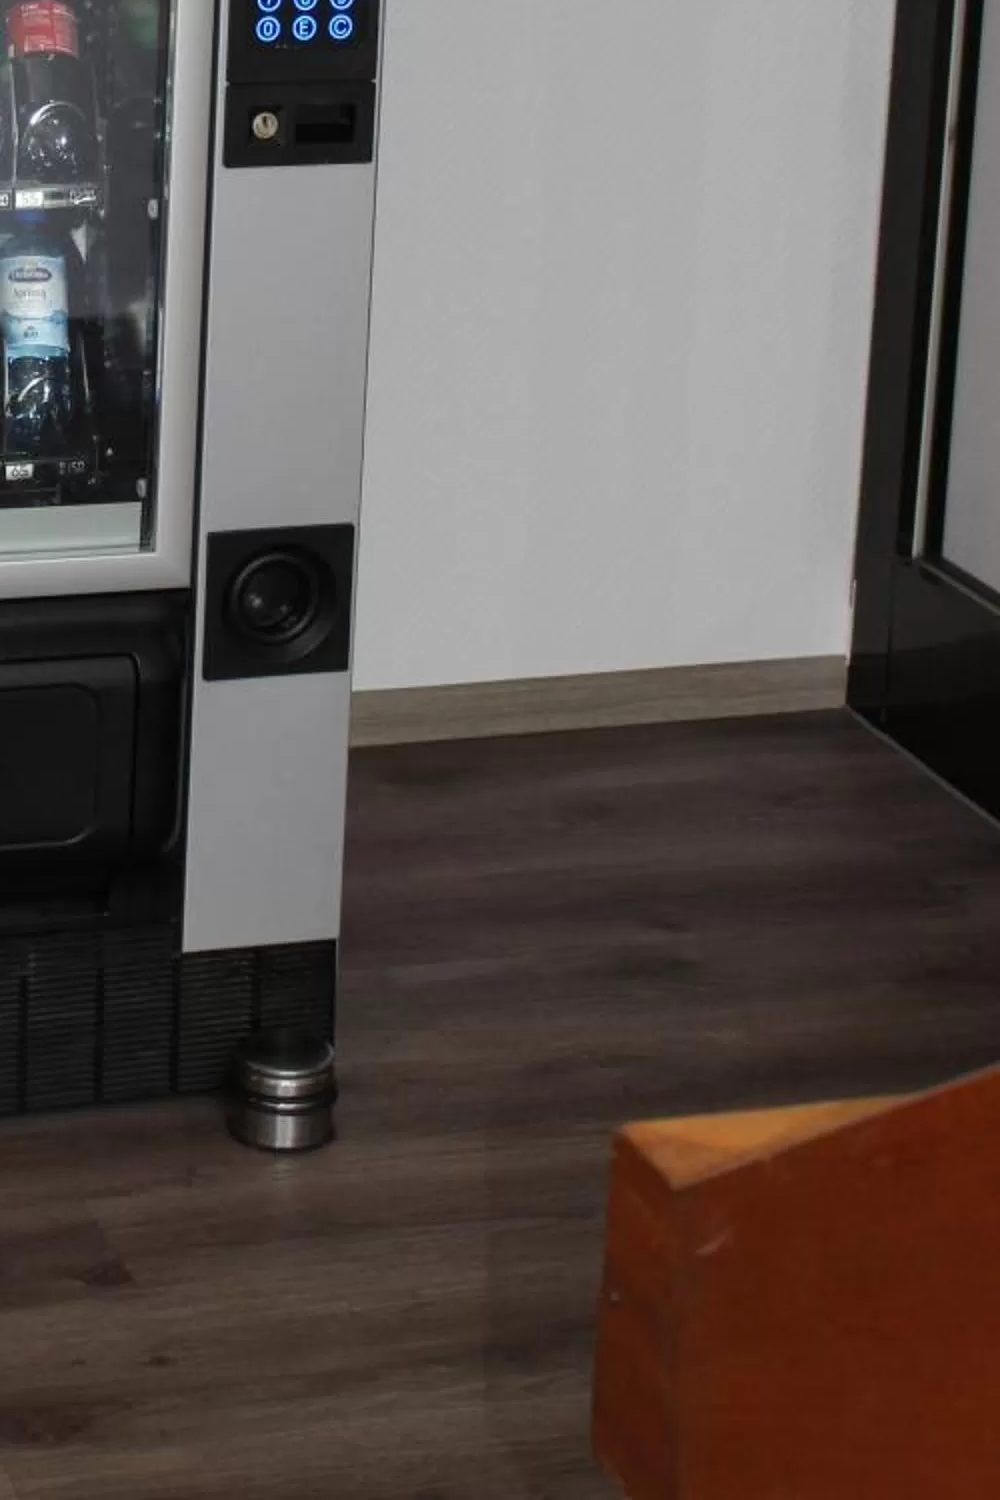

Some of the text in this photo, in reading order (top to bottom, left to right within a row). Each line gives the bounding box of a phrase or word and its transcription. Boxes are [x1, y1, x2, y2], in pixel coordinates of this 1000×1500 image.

[263, 19, 347, 37] 0 E C
